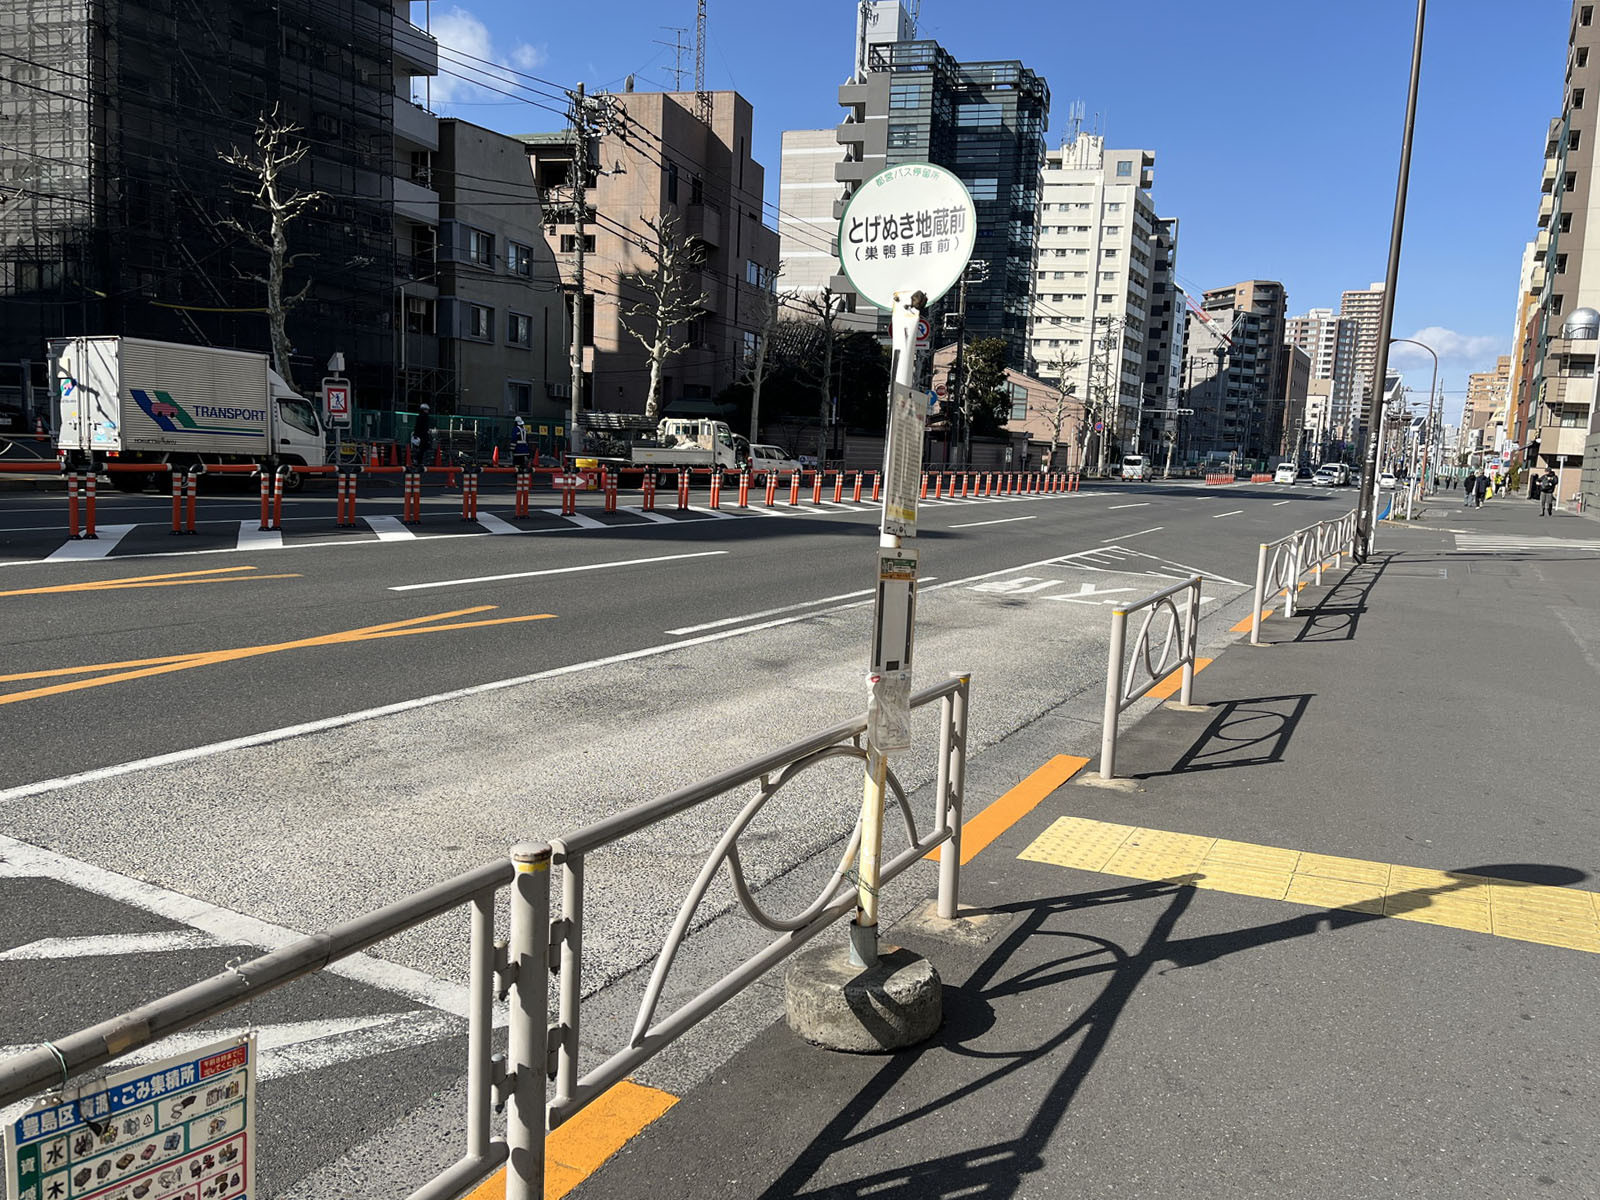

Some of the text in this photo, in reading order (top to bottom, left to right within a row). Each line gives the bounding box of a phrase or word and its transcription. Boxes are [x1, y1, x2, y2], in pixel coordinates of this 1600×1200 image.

[875, 167, 941, 187] 都営バス停留所
[849, 205, 966, 243] とげぬき地蔵前
[855, 236, 960, 261] （巣鴨車庫前）
[193, 405, 266, 421] TRANSPORT
[22, 1104, 75, 1139] 豊島区
[46, 1144, 64, 1164] 水
[47, 1181, 64, 1199] 木
